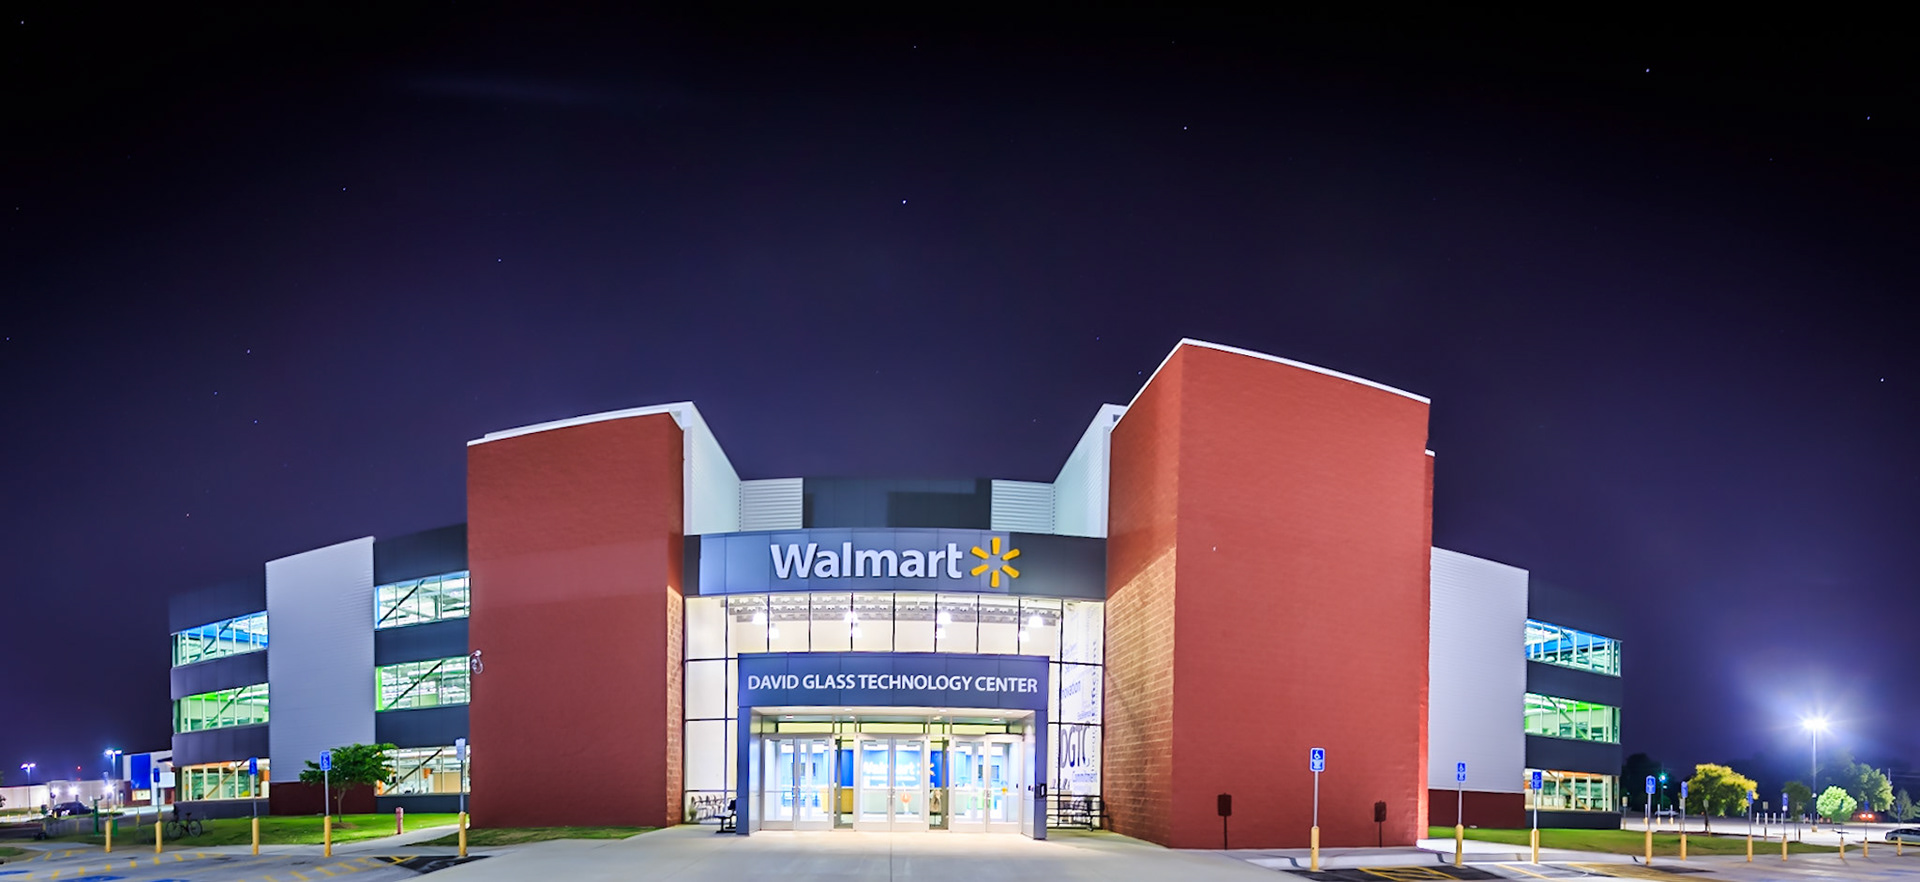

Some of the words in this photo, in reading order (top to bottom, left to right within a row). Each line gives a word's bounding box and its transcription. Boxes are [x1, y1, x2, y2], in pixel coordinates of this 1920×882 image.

[770, 541, 963, 579] Walmart
[748, 674, 799, 690] DAVID
[802, 673, 856, 690] GLASS
[858, 673, 973, 692] TECHNOLOGY
[975, 675, 1038, 693] CENTER
[862, 760, 915, 775] Walart
